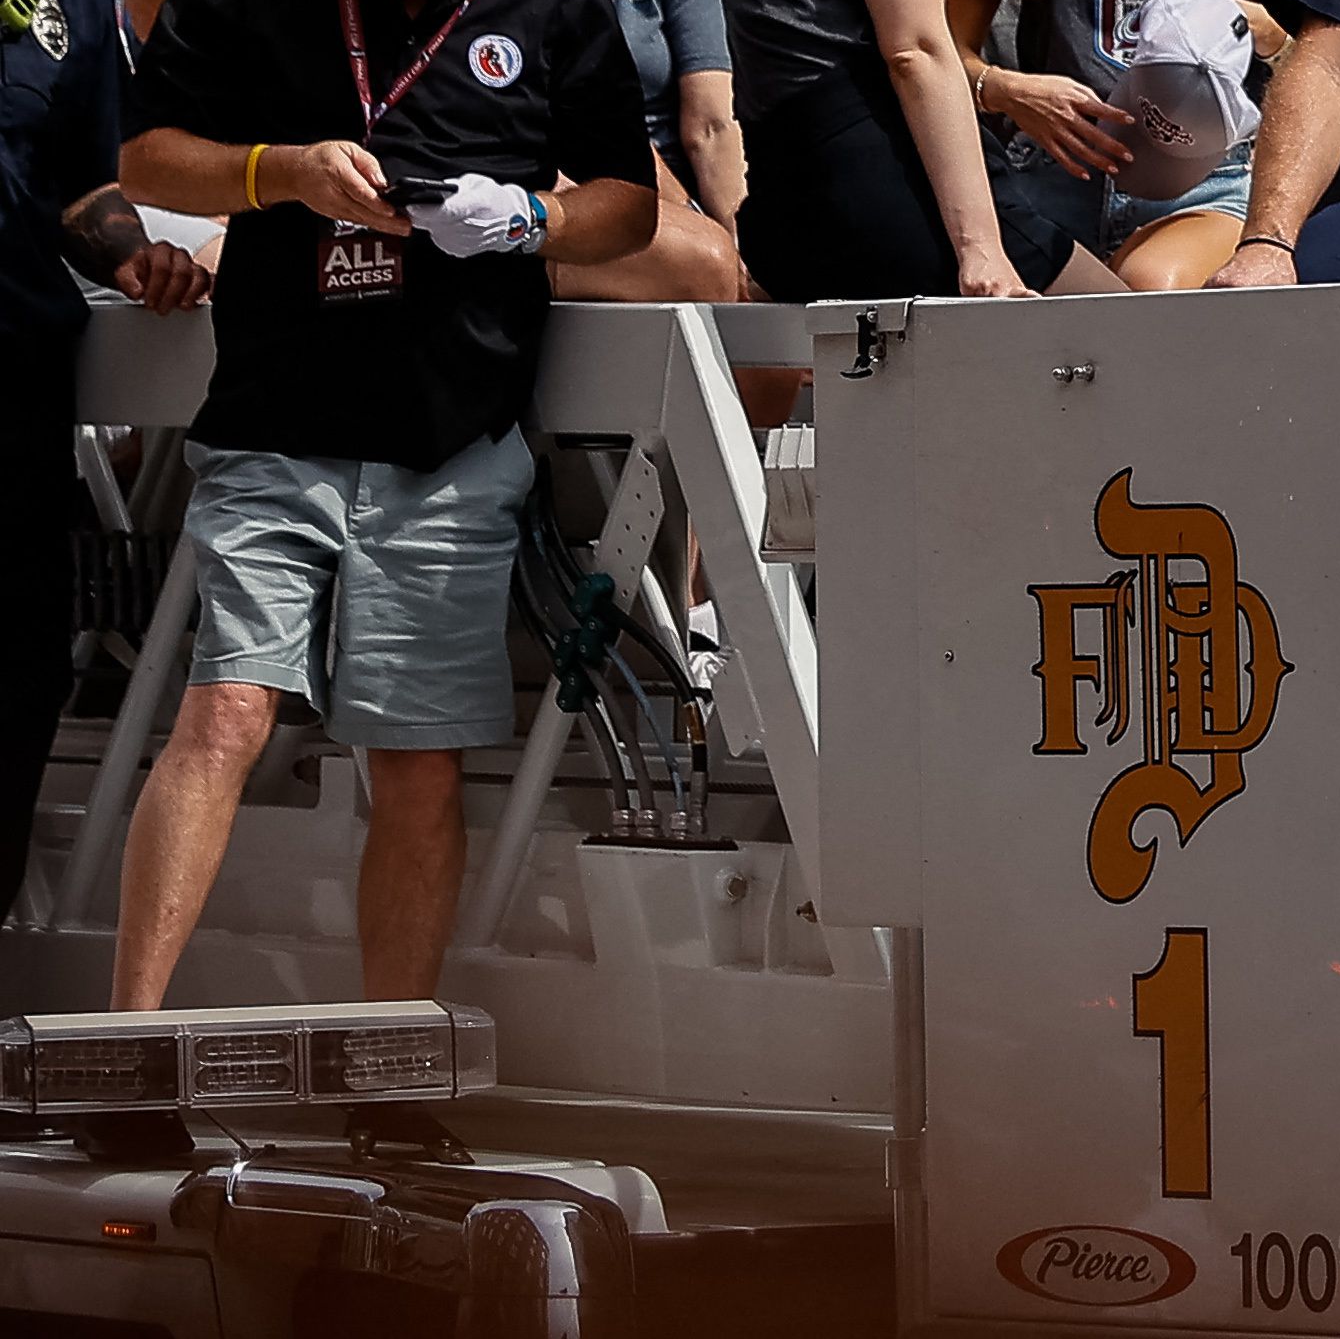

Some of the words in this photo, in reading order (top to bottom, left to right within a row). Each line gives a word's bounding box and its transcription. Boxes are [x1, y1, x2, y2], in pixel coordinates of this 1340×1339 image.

[324, 241, 396, 273] ALL
[326, 268, 394, 289] ACCESS
[1132, 926, 1213, 1200] 1
[1036, 1236, 1152, 1284] Pierce
